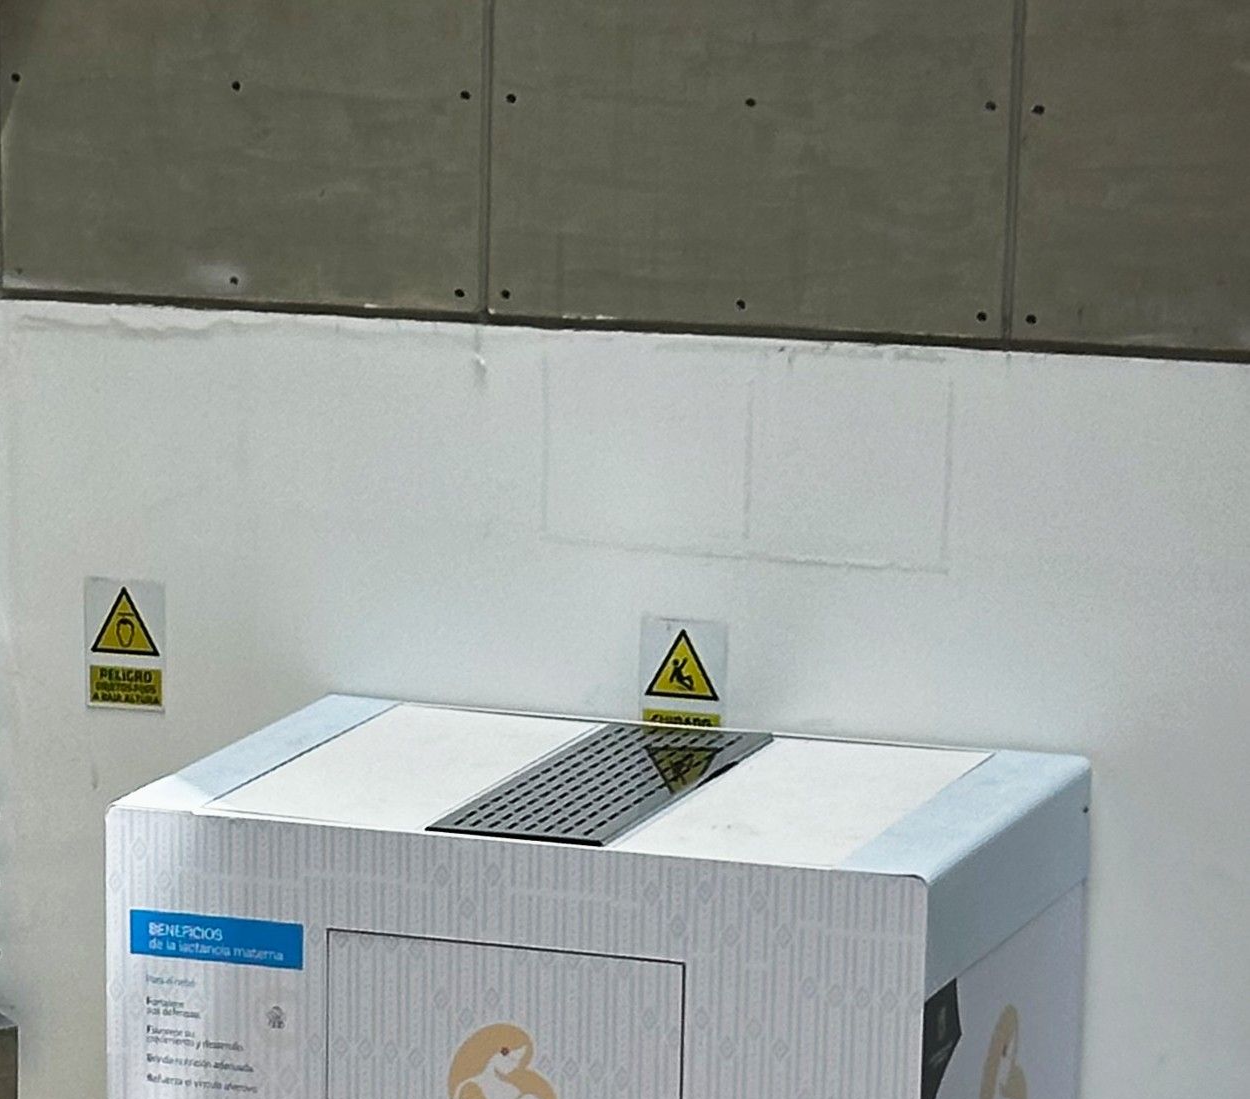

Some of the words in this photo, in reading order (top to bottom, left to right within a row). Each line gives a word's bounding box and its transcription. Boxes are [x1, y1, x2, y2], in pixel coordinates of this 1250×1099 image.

[100, 667, 152, 683] PELIGRO
[148, 921, 223, 942] BENEFICIOS
[148, 937, 163, 951] de
[166, 940, 177, 952] la
[178, 941, 232, 957] lactancia
[233, 947, 284, 962] materna
